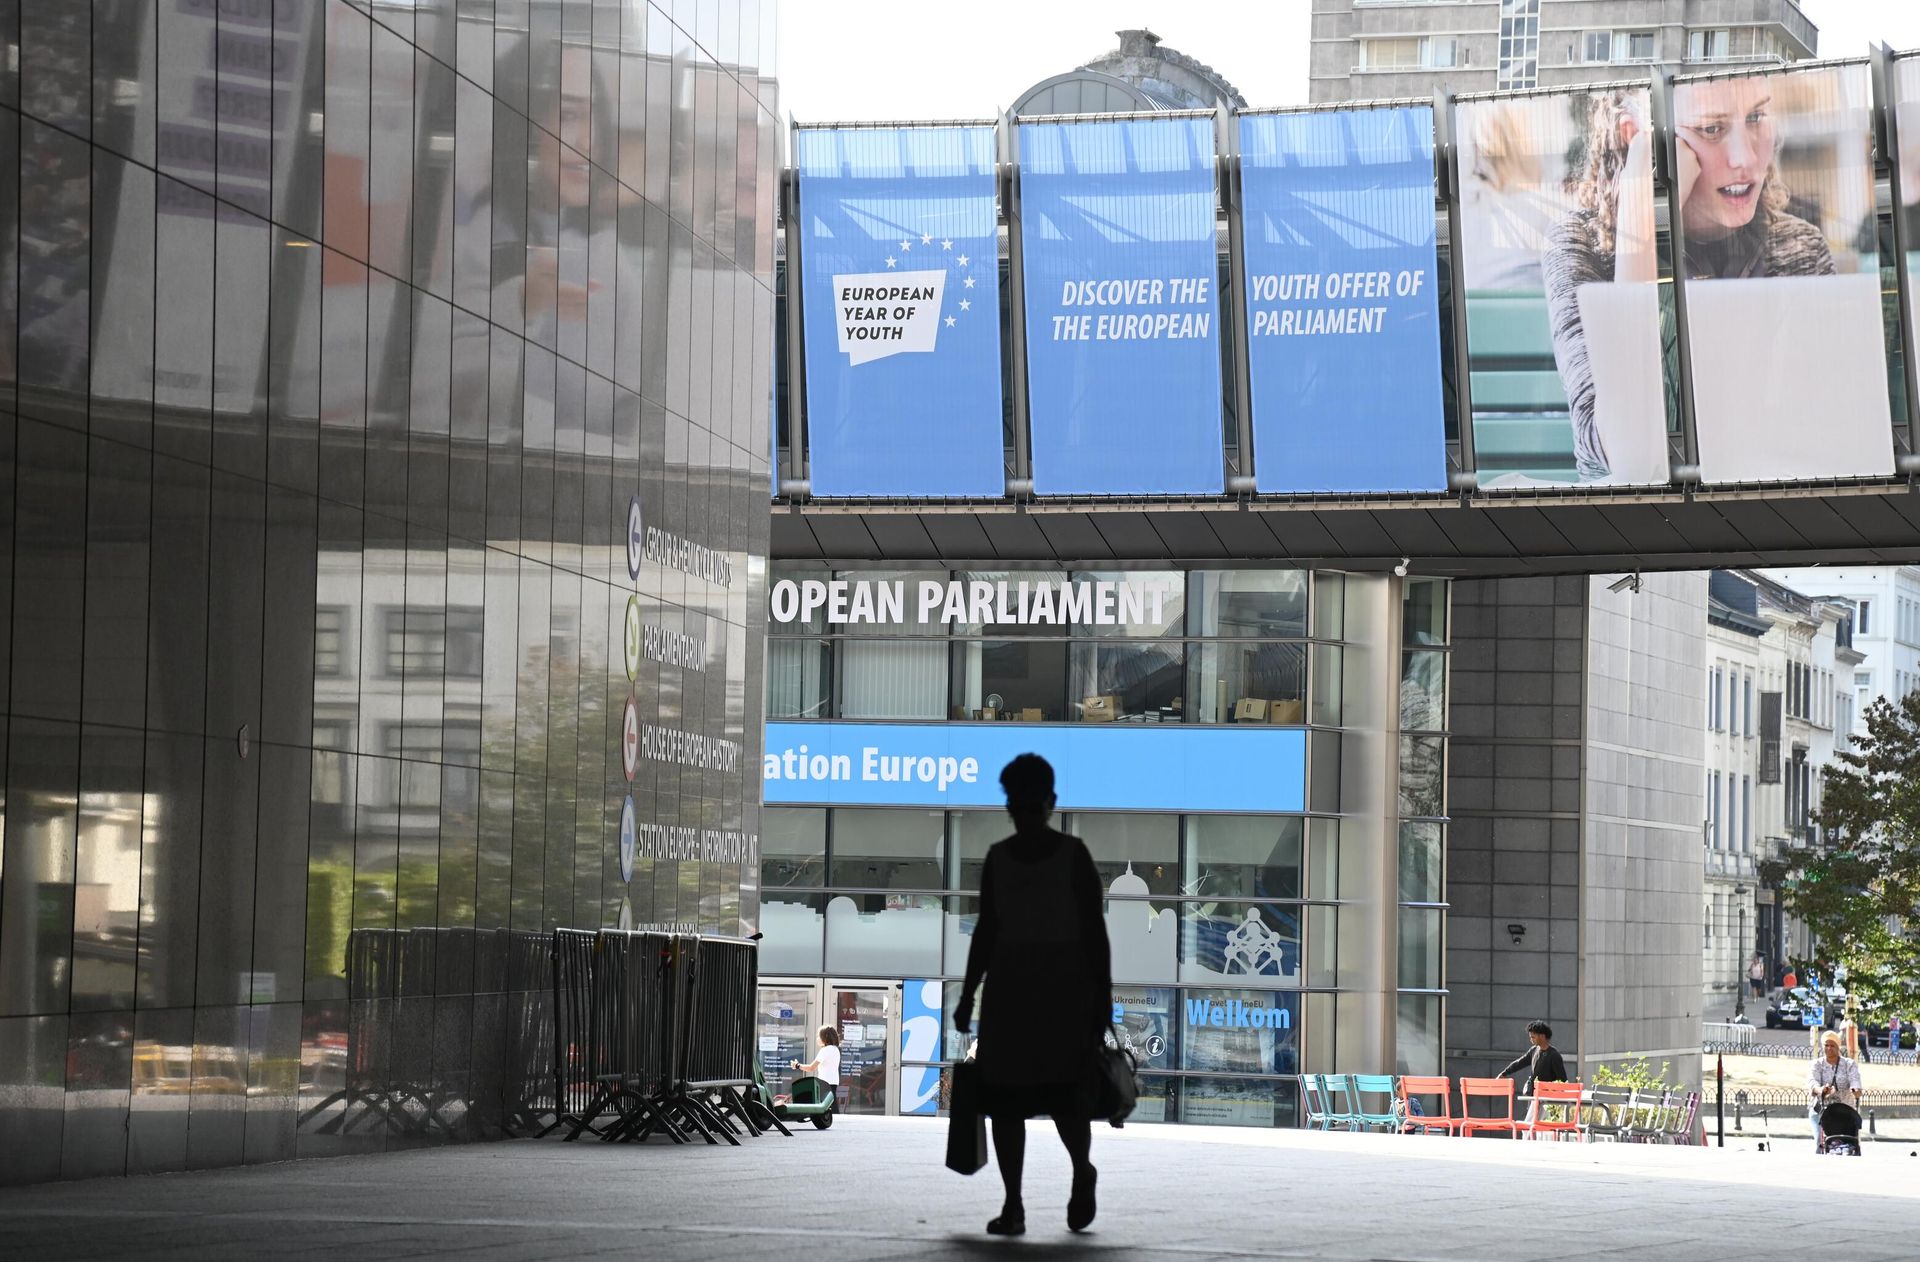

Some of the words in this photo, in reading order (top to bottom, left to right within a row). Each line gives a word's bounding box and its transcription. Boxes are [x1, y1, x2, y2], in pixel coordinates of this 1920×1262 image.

[842, 287, 935, 301] EUROPEAN
[1062, 279, 1164, 306] DISCOVER
[1169, 278, 1210, 304] THE
[1252, 273, 1321, 301] YOUTH
[1325, 271, 1391, 299] OFFER
[1396, 270, 1425, 297] OF
[844, 307, 888, 321] YEAR
[893, 306, 916, 321] OF
[1052, 315, 1092, 341] THE
[1096, 313, 1210, 340] EUROPEAN
[1253, 307, 1387, 336] PARLIAMENT
[846, 326, 903, 340] YOUTH
[646, 526, 672, 566] GROUP
[714, 550, 732, 590] VISITS
[768, 579, 904, 624] OPEAN
[918, 580, 1170, 625] PARLIAMENT
[643, 624, 706, 673] PARLAMENTARIUM
[641, 724, 666, 762] HOUSE
[667, 728, 677, 762] OF
[678, 730, 712, 769] EUROPEAN
[712, 737, 737, 773] HISTORY
[862, 747, 979, 792] Europe
[639, 823, 669, 858] STATION
[669, 826, 695, 860] EUROPE
[701, 829, 741, 864] INFORMATION
[1186, 999, 1290, 1029] Welkom
